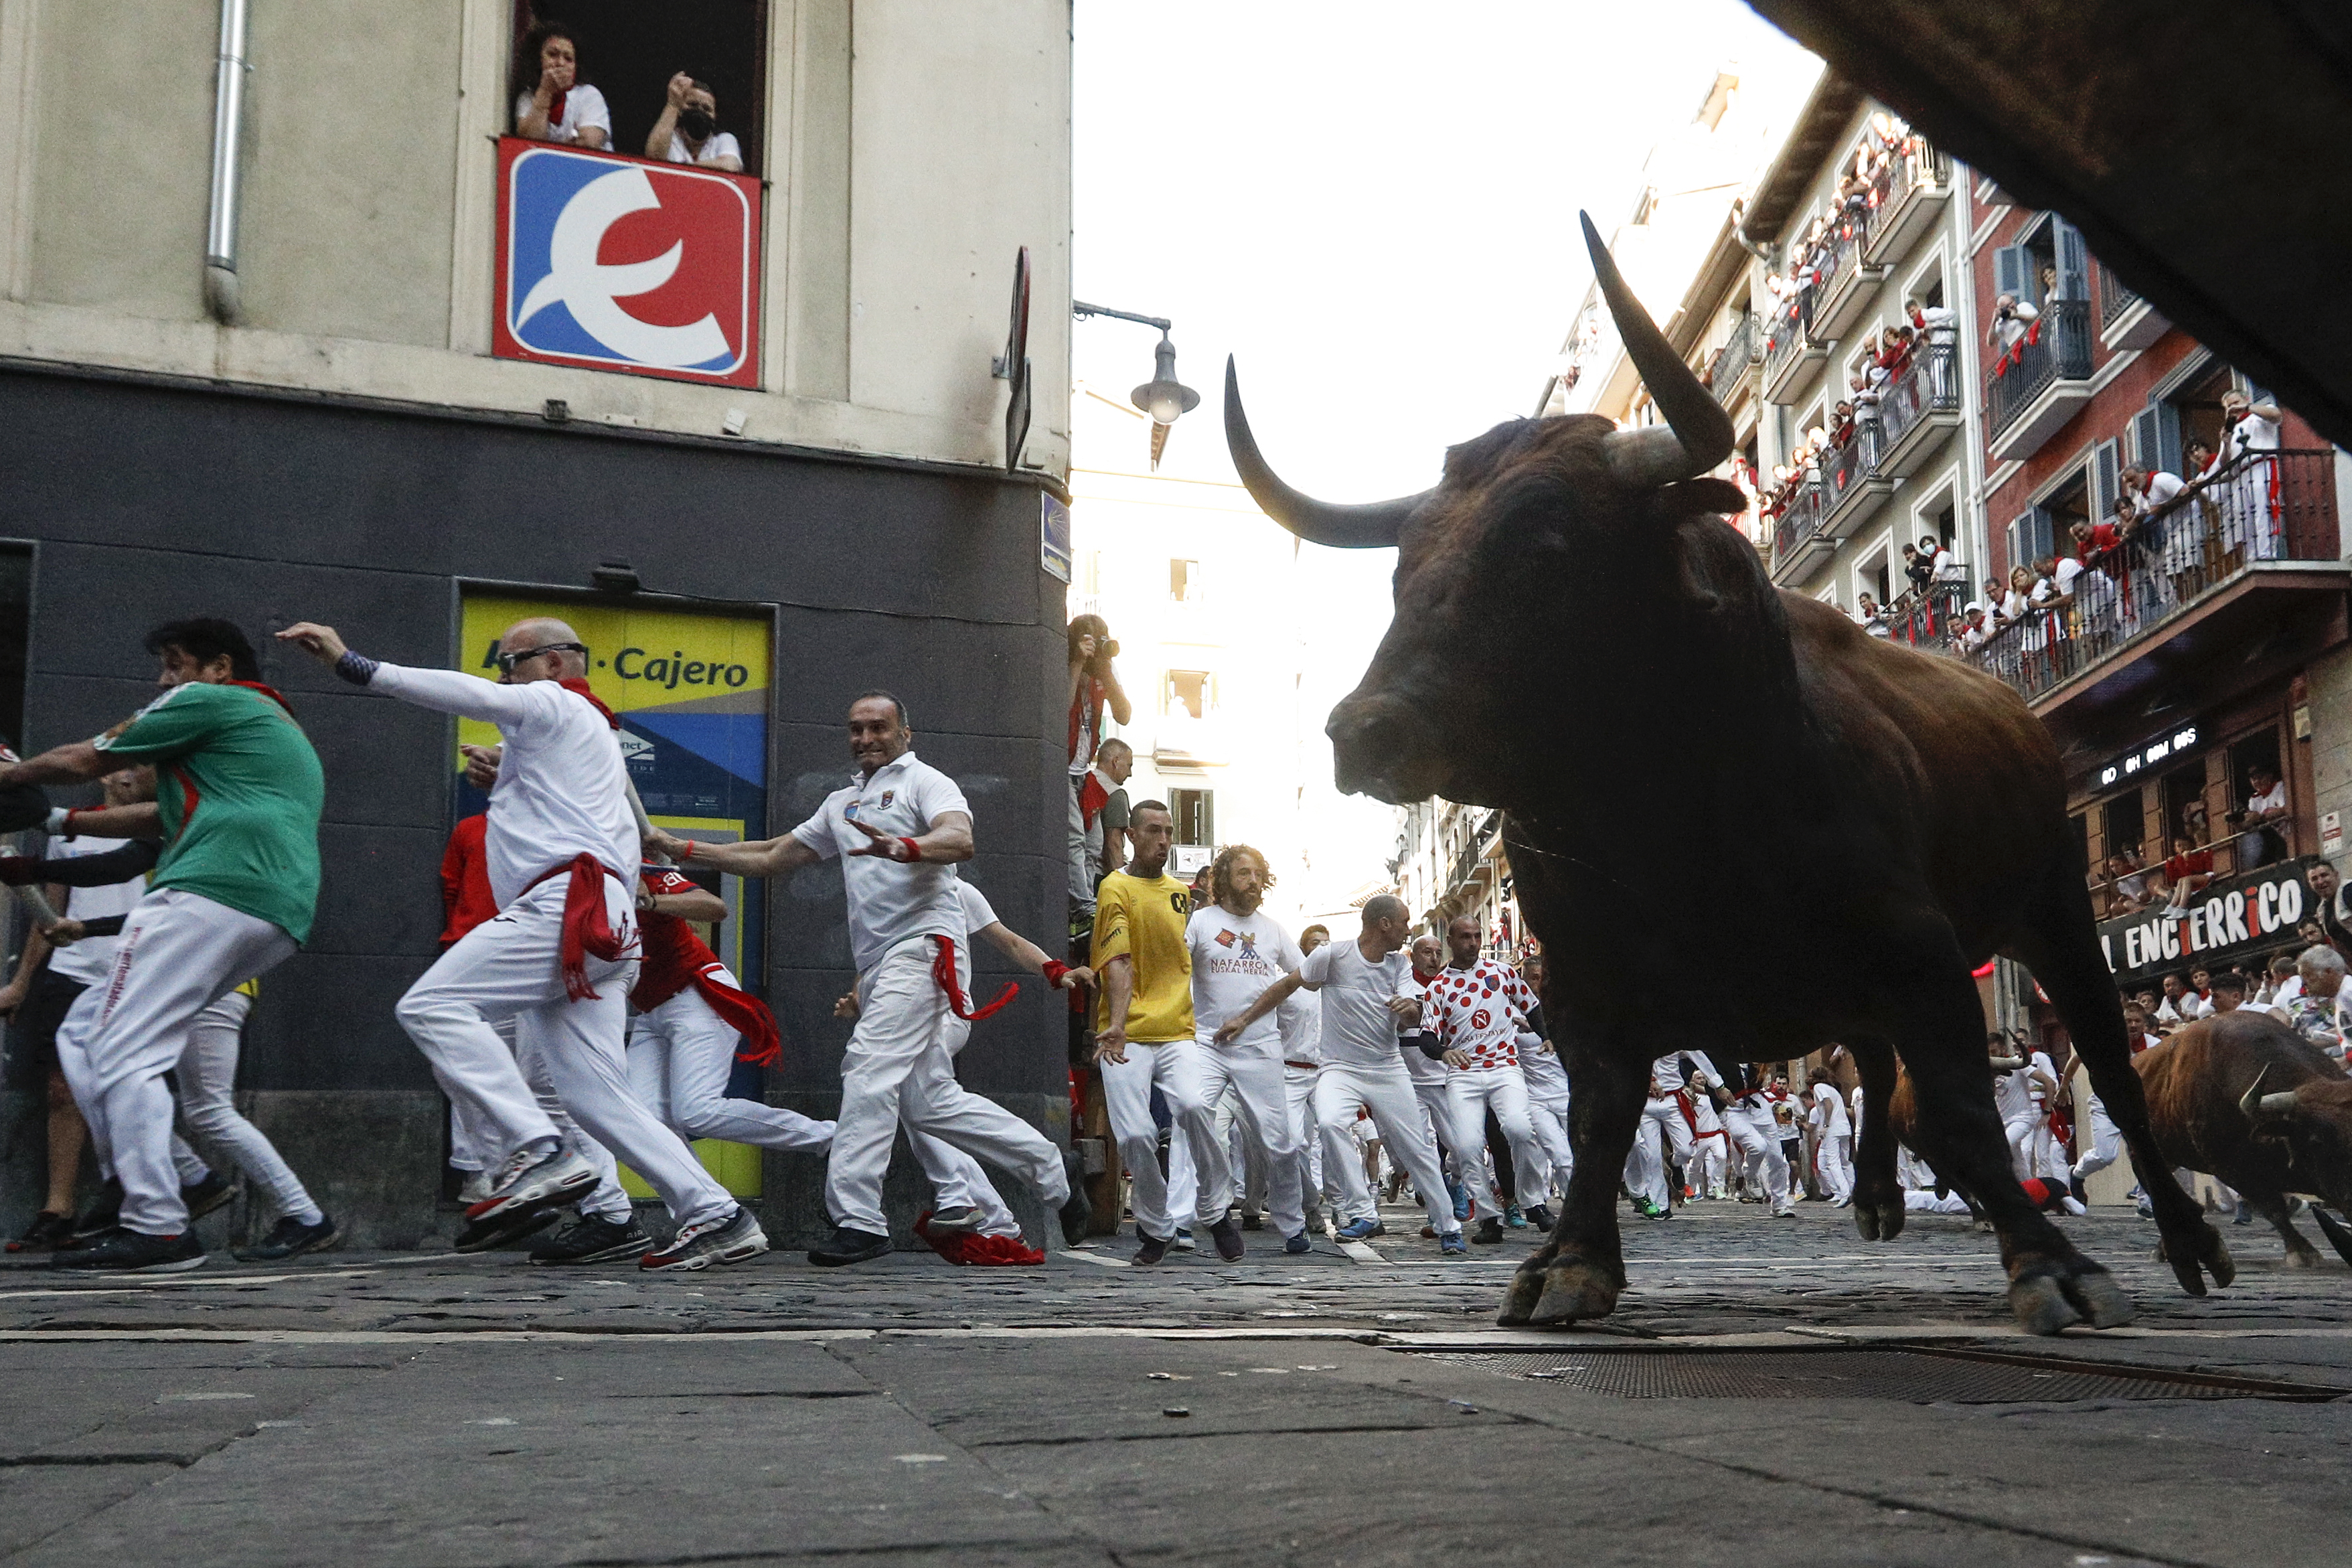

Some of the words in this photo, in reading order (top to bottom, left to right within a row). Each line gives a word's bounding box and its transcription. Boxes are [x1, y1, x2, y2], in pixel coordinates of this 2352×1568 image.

[614, 647, 749, 689] Cajero
[2101, 935, 2116, 974] L
[1210, 959, 1267, 969] NAFARROA
[1243, 968, 1269, 977] HERRIA
[1474, 1010, 1487, 1028] Ñ
